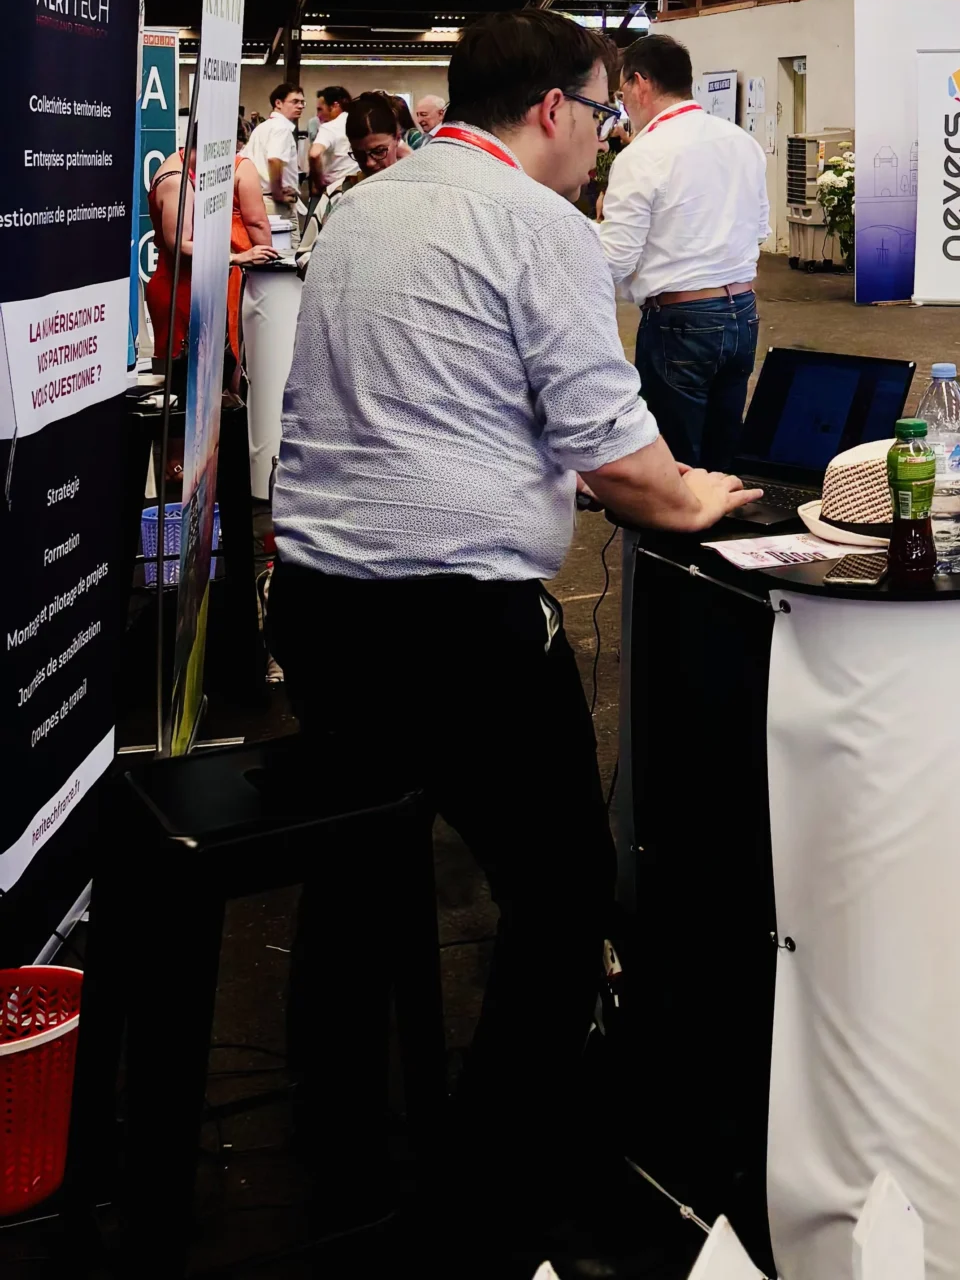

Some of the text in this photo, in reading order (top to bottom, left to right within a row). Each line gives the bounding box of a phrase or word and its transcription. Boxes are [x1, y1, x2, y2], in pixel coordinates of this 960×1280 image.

[29, 94, 112, 118] Collectivités territoriales
[141, 65, 168, 110] A
[24, 149, 113, 170] Entreprises patrimoniales
[0, 200, 126, 228] estionnaires de patrimoines privés
[29, 303, 106, 343] LA NUMÉRISATION DE
[37, 335, 98, 374] VOS PATRIMOINES
[31, 364, 102, 410] VOUS QUESTIONNE ?
[47, 475, 80, 507] Stratégie
[43, 532, 80, 567] Formation
[7, 562, 109, 651] Montage et pilotage de projets
[17, 620, 101, 707] Journées de sensibilisation
[31, 677, 88, 748] Groupes de travail
